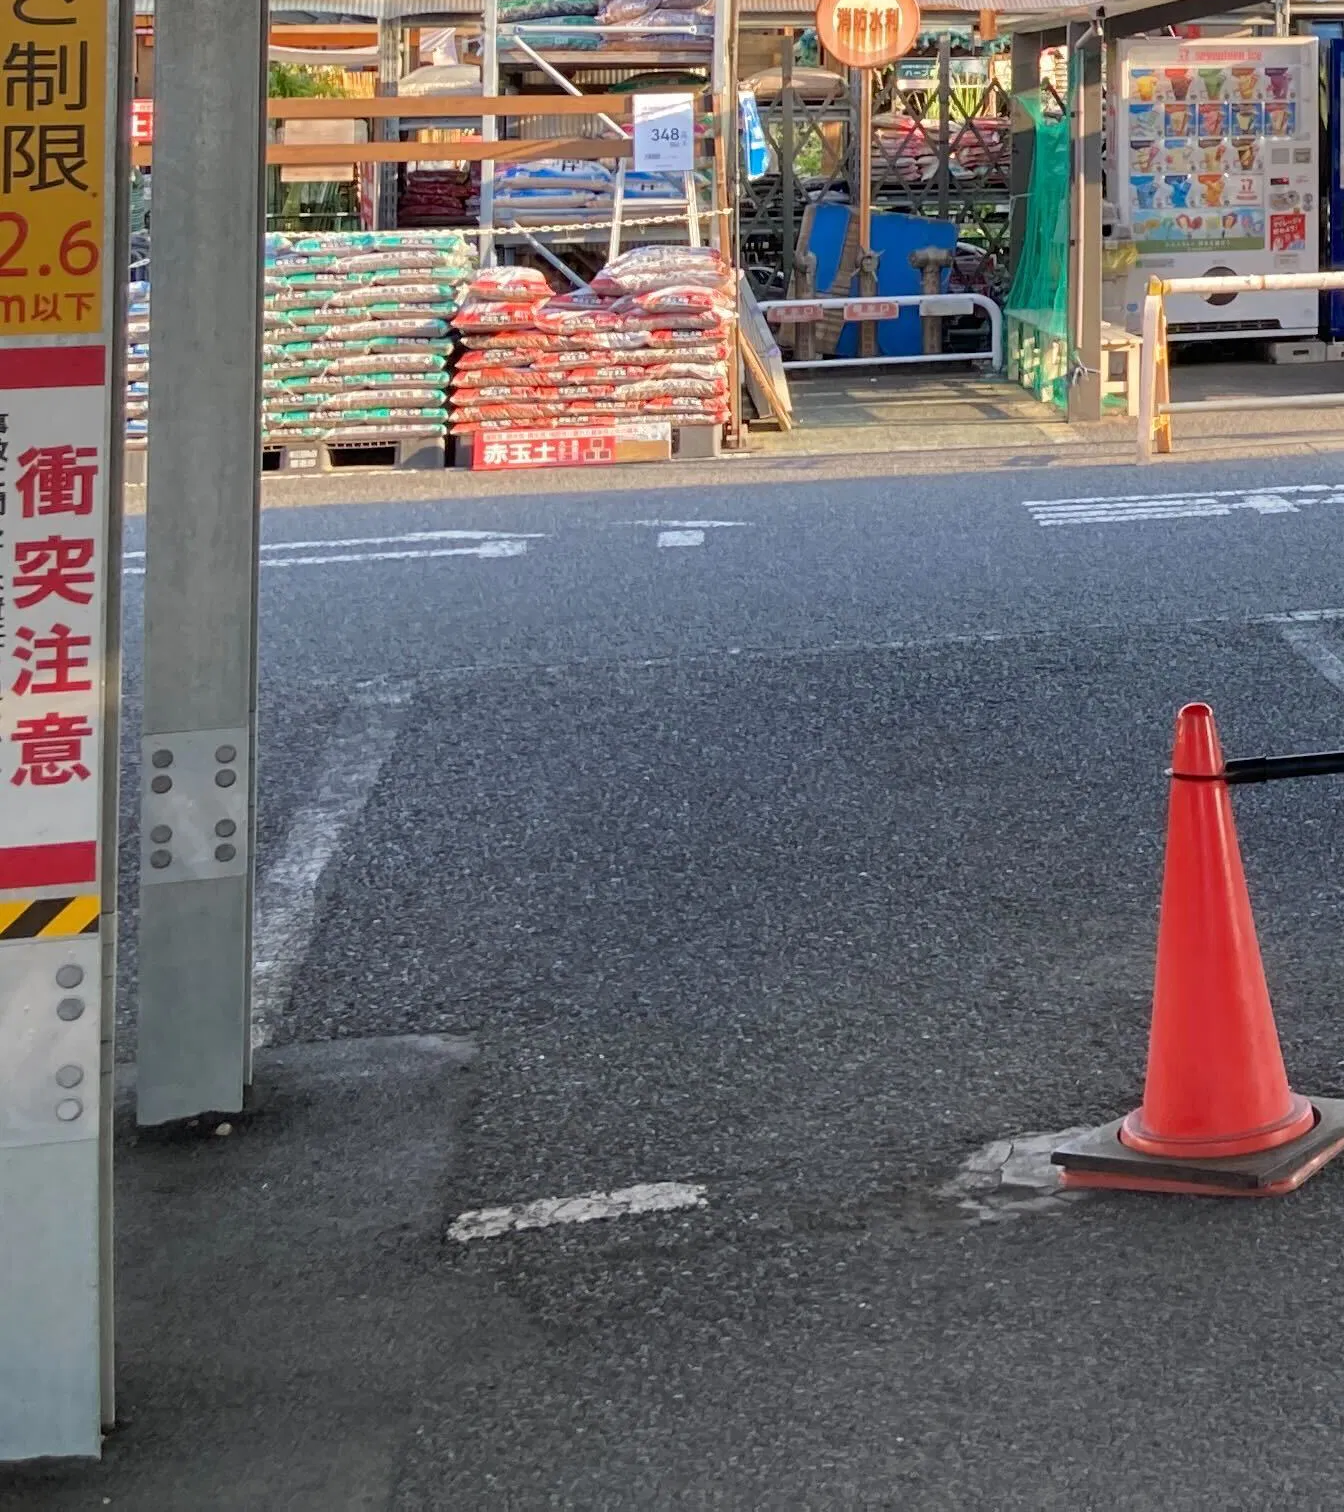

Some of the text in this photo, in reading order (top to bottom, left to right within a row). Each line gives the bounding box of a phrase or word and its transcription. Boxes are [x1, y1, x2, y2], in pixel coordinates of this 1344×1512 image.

[837, 7, 900, 33] 消防水利
[651, 127, 680, 141] 348
[0, 210, 99, 277] 2.6
[483, 441, 557, 465] 赤玉土
[10, 444, 98, 787] 衝突注意
